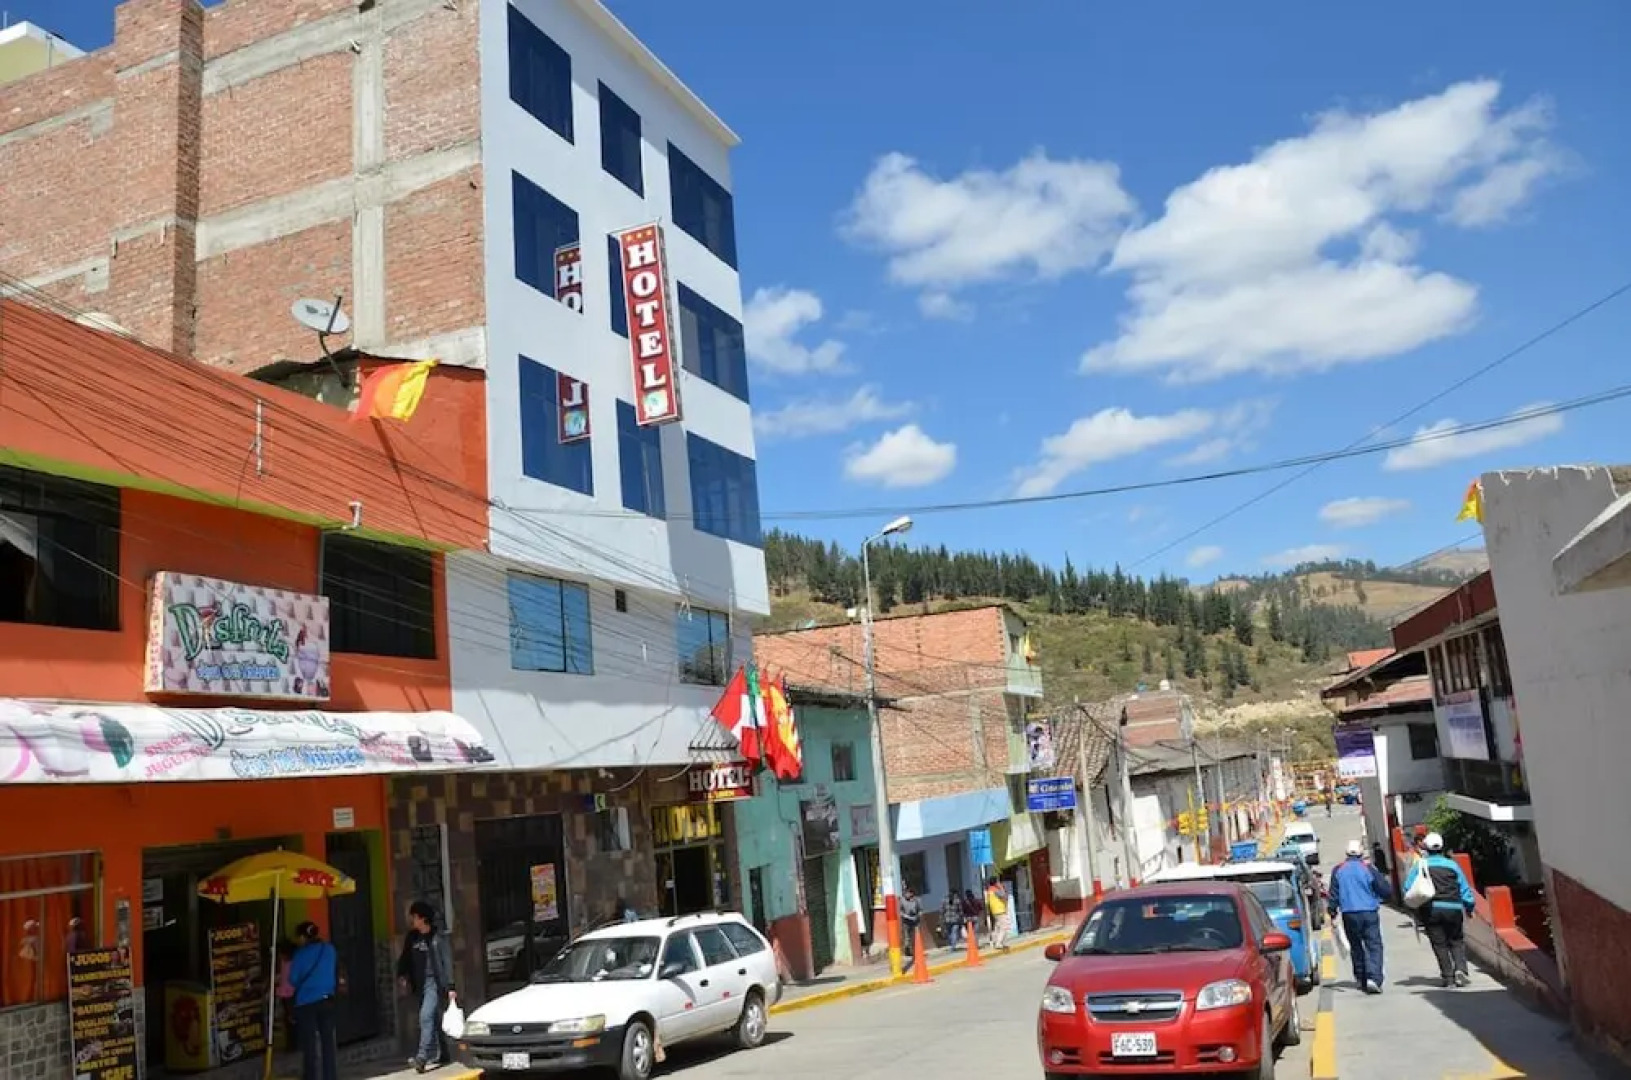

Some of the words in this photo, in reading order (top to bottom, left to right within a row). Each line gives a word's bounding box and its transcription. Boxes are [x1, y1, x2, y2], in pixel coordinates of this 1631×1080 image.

[627, 240, 666, 389] HOTEL
[689, 766, 750, 792] HOTEL
[652, 804, 722, 842] HOTEL
[75, 952, 111, 966] JUGOS
